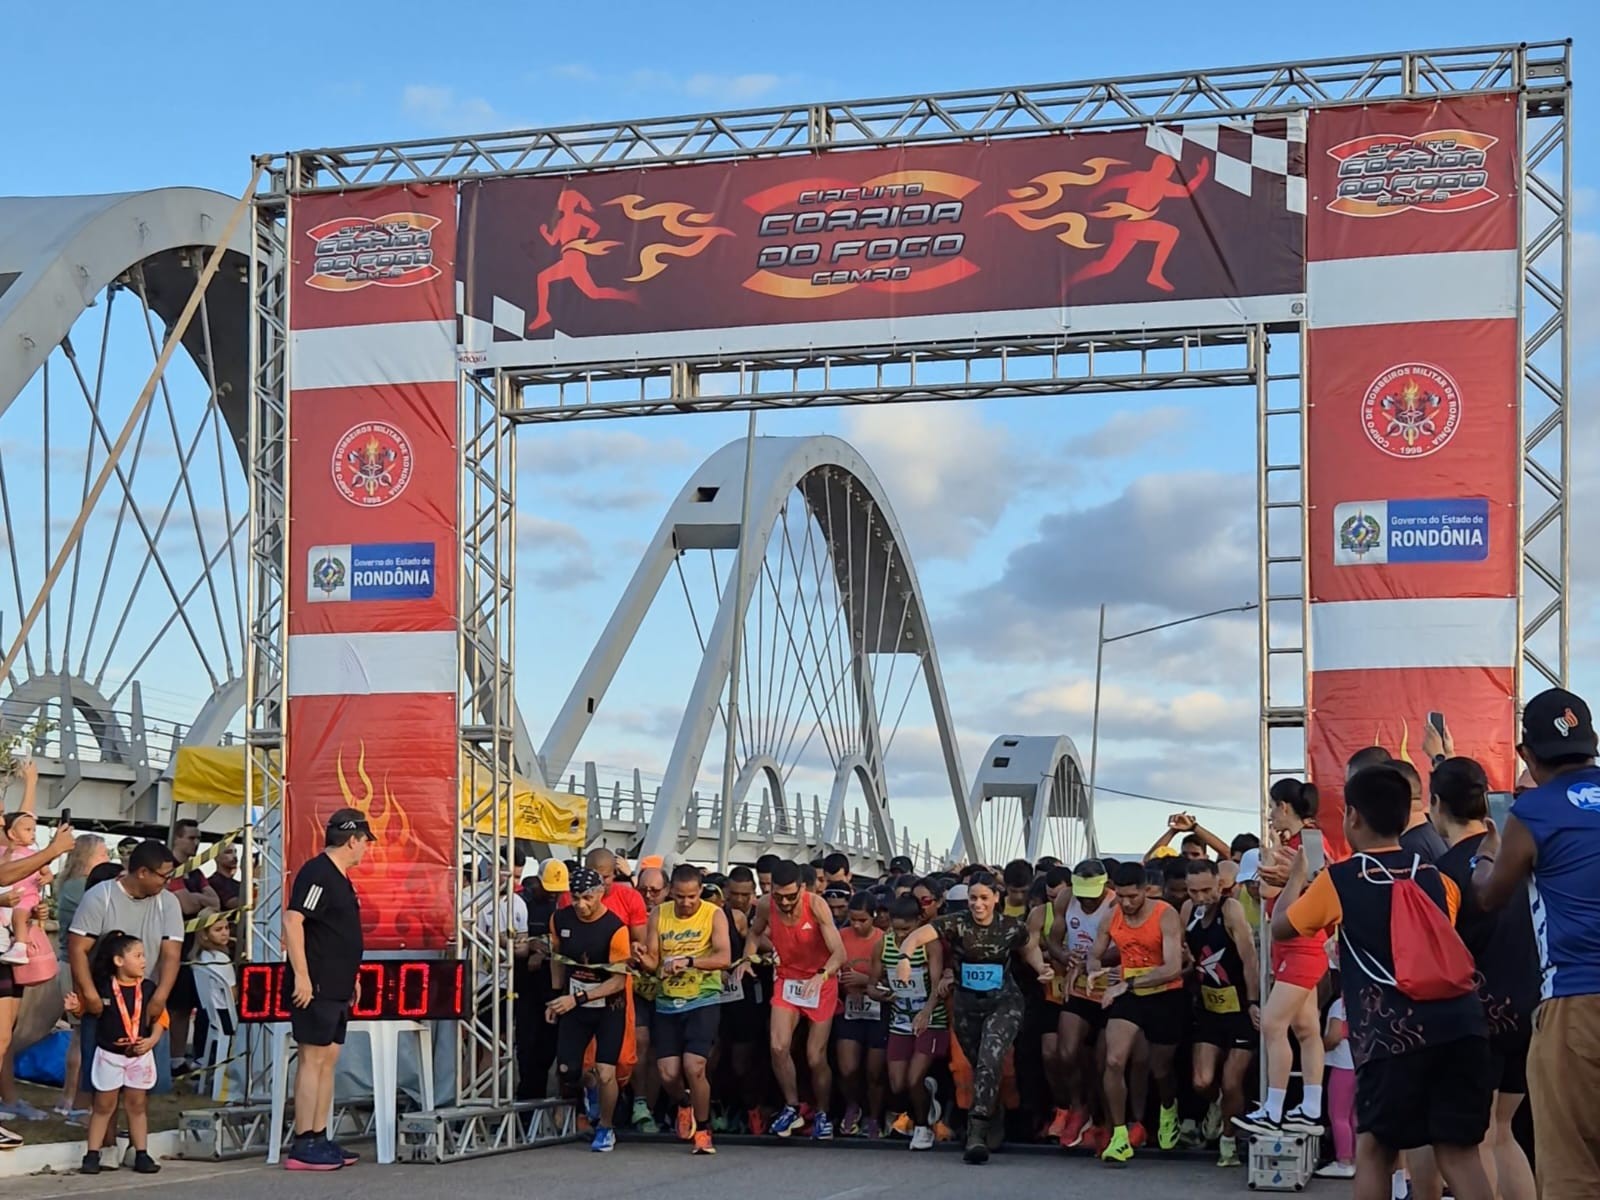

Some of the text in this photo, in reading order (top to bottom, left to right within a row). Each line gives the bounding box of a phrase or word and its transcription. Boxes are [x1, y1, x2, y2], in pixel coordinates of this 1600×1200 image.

[1340, 151, 1485, 175] CORRIDA
[799, 183, 924, 205] CIRCUITO
[1339, 172, 1486, 196] DO FOGO
[758, 201, 964, 237] CORRIDA
[317, 231, 431, 254] CORRIDA
[757, 233, 965, 268] DO FOGO
[316, 250, 431, 273] DO FOGO
[1412, 367, 1447, 387] MILITAR
[1391, 514, 1484, 525] Governo do Estado de
[1391, 526, 1484, 547] RONDÔNIA
[353, 557, 431, 567] Governo do Estado de
[353, 566, 430, 587] RONDÔNIA
[966, 970, 994, 981] 1037
